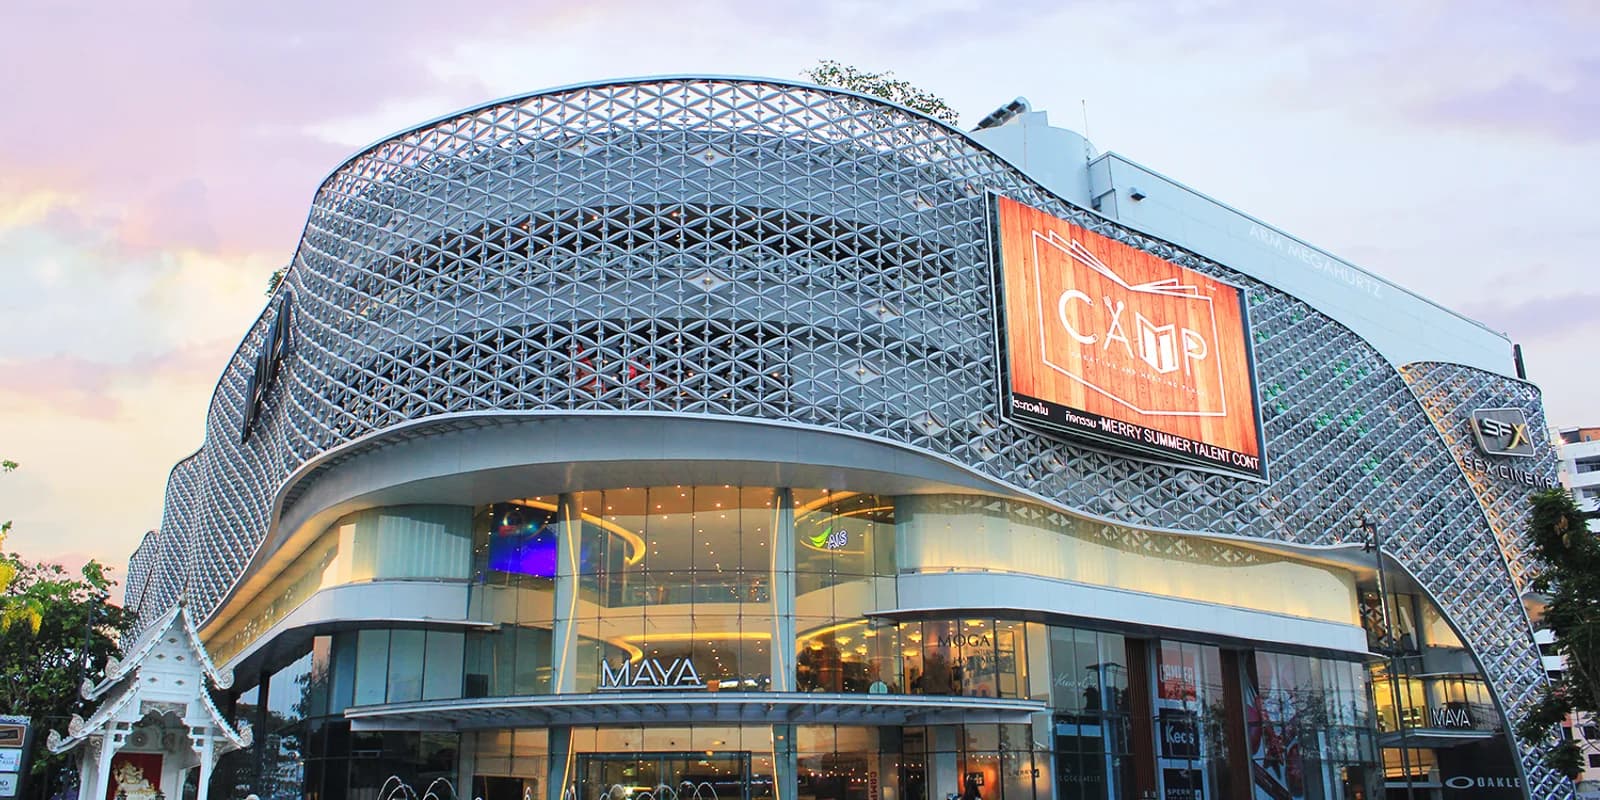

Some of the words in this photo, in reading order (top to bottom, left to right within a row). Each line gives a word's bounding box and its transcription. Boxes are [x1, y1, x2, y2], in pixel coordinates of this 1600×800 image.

[1058, 288, 1208, 377] CAMP
[1482, 417, 1529, 450] SFX
[1143, 429, 1192, 453] SUMMER
[1192, 442, 1231, 463] TALENT
[1232, 452, 1259, 470] CONT
[1463, 456, 1494, 475] SFX
[828, 530, 849, 550] AIS
[938, 633, 991, 648] MOGA
[601, 657, 701, 687] MAYA
[1432, 707, 1471, 728] MAYA
